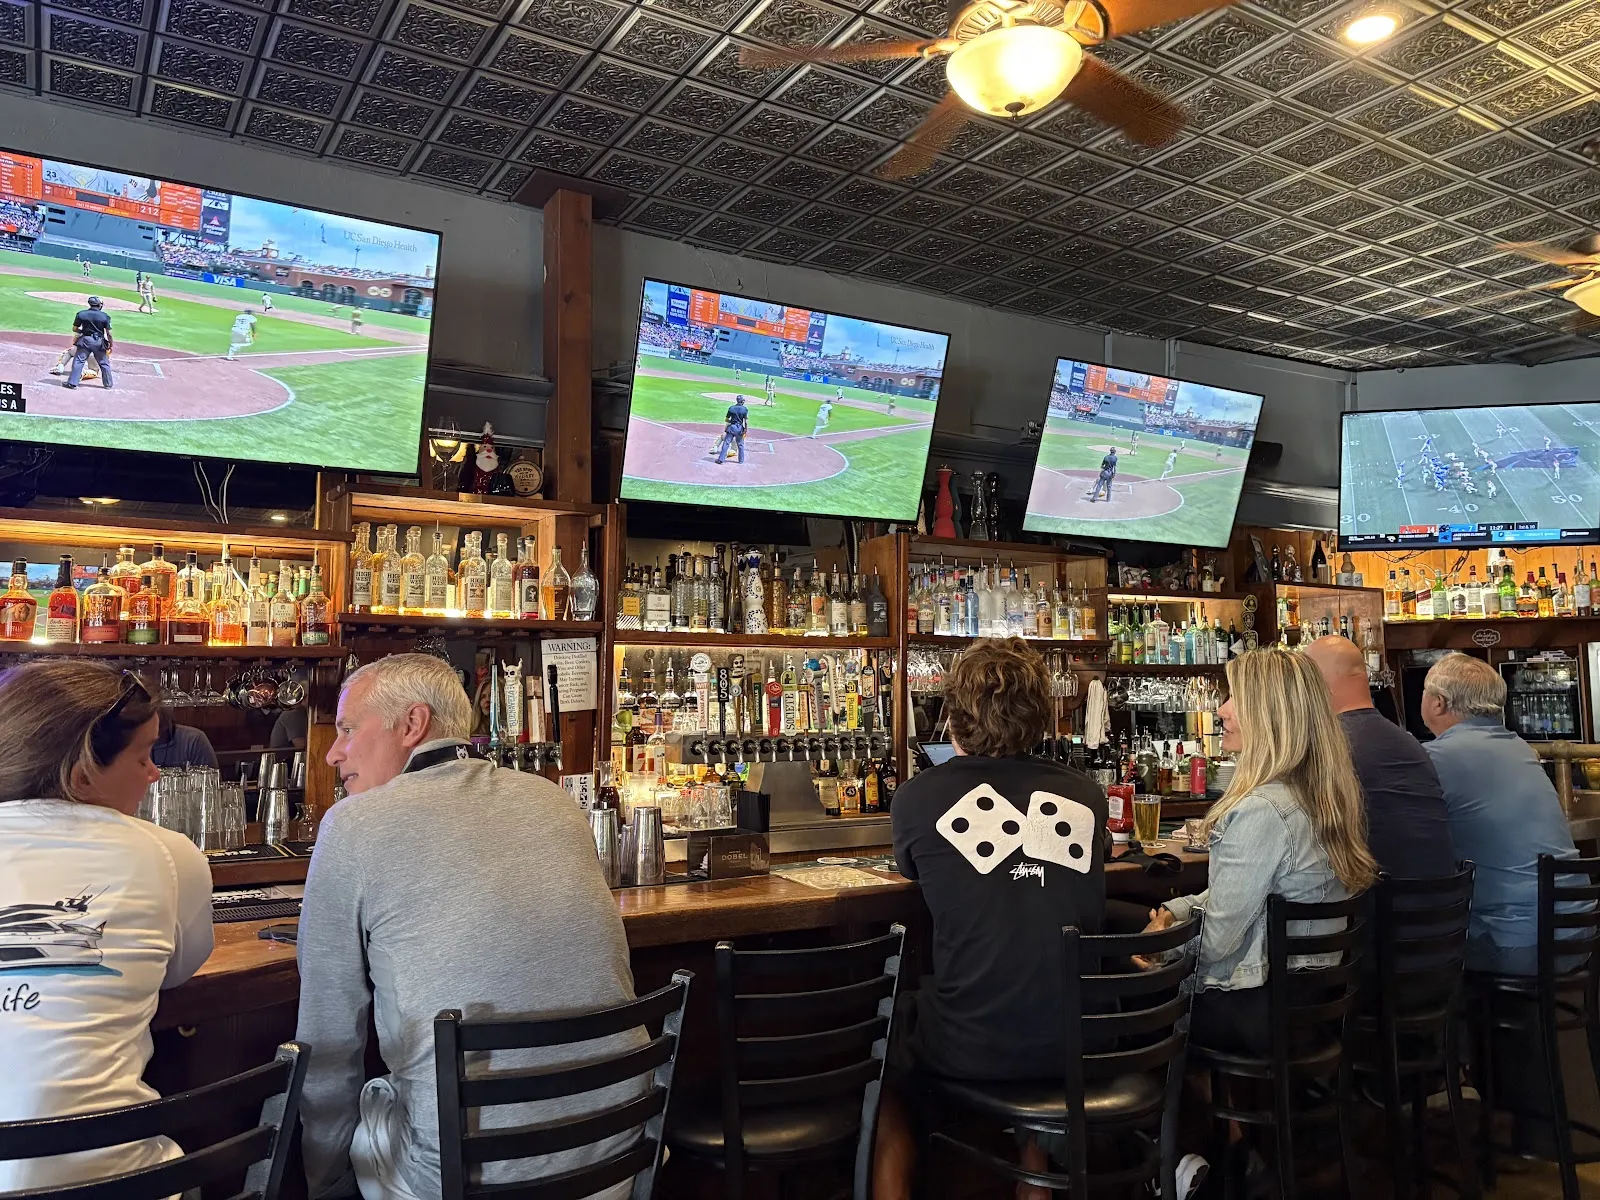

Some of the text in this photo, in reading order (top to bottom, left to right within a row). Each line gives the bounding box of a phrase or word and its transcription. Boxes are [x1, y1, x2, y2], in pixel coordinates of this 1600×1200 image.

[140, 205, 159, 216] 212
[343, 230, 418, 252] UC San Diego Health
[213, 275, 237, 286] VISA
[810, 375, 824, 383] VISA
[10, 400, 17, 410] A
[1551, 494, 1583, 504] 50
[1427, 526, 1435, 534] 14
[548, 642, 591, 651] WARNING:
[719, 668, 728, 699] 805
[785, 693, 795, 730] SOCIETE
[846, 788, 856, 796] 43
[721, 853, 748, 861] DOBEL
